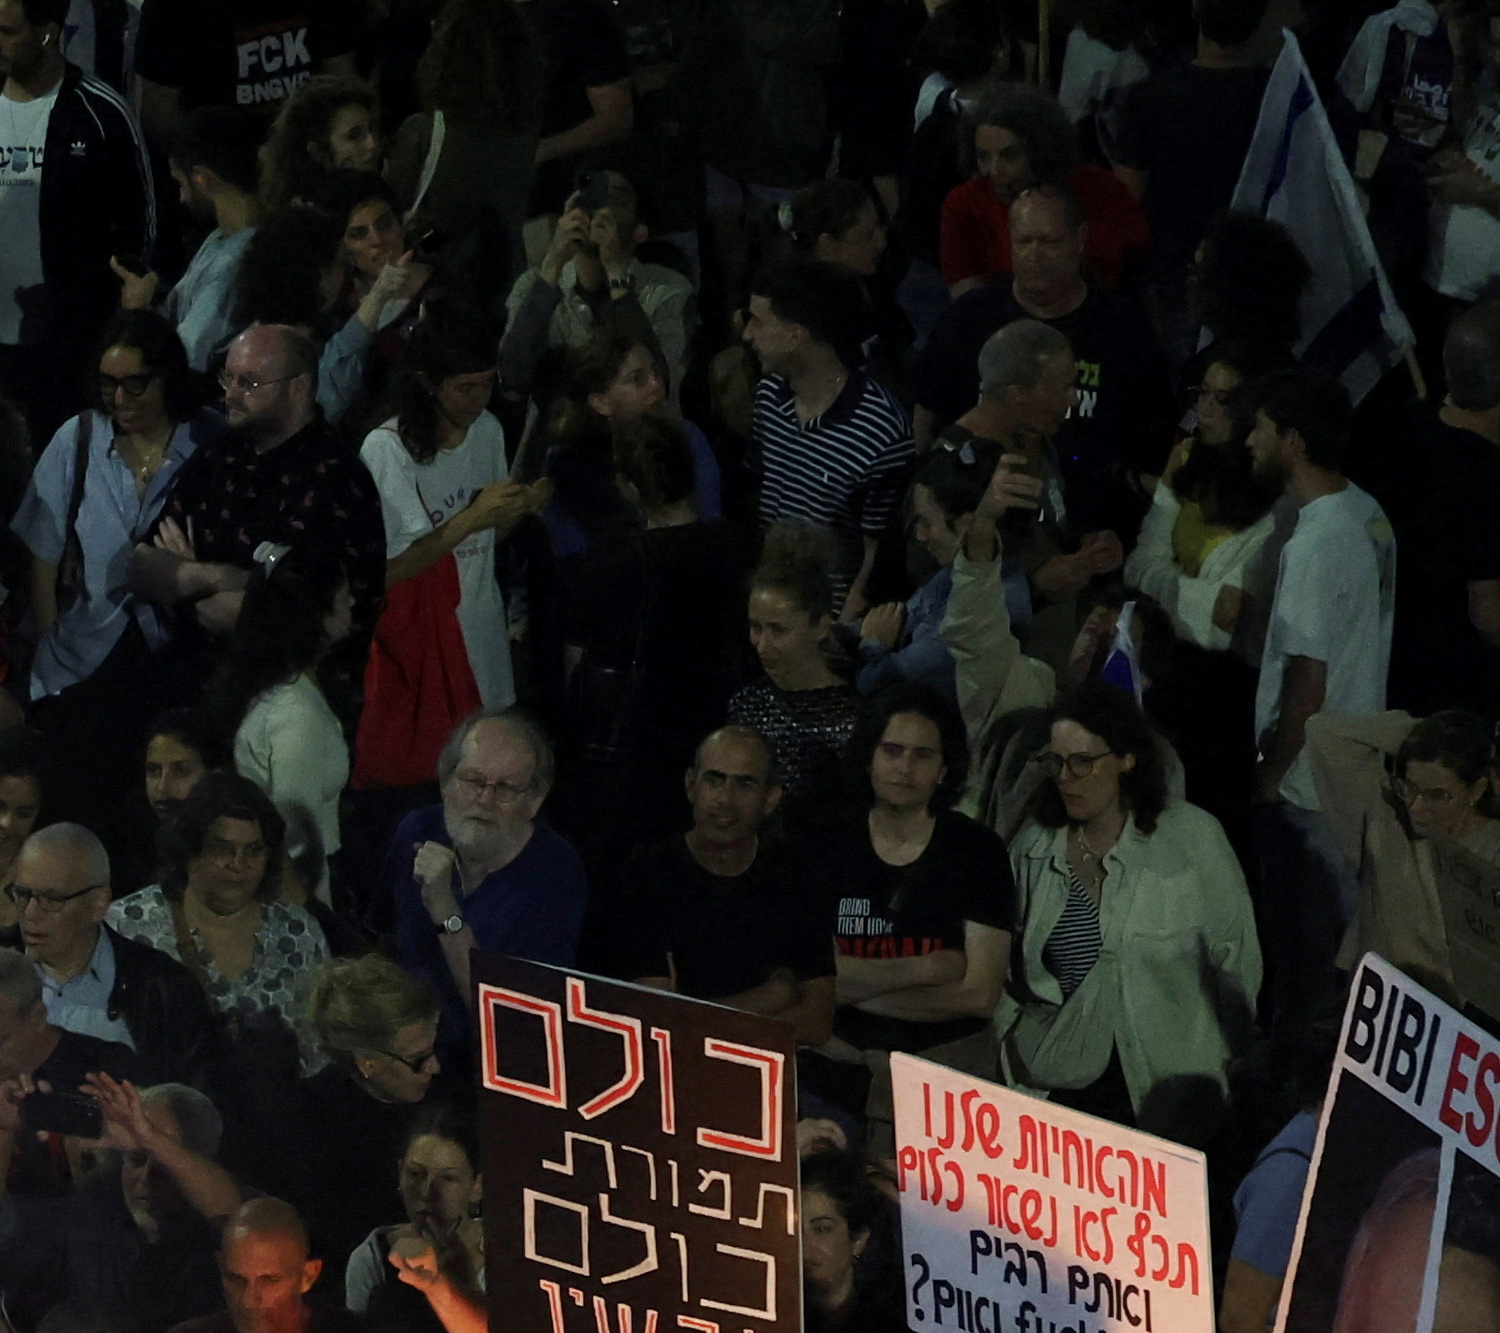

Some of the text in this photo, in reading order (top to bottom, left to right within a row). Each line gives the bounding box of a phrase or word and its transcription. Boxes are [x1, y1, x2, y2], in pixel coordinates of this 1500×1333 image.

[237, 28, 311, 78] FCK
[837, 916, 865, 936] THEM
[838, 897, 871, 916] BRING
[478, 976, 785, 1162] כולם
[1345, 965, 1441, 1105] BIBI
[541, 1131, 795, 1237] תמורת
[923, 1082, 1166, 1218] מהאחיות שלנו
[523, 1187, 777, 1321] כולם
[897, 1145, 1200, 1297] תכף לא נשאר כלום
[970, 1229, 1152, 1333] ואתם רבים
